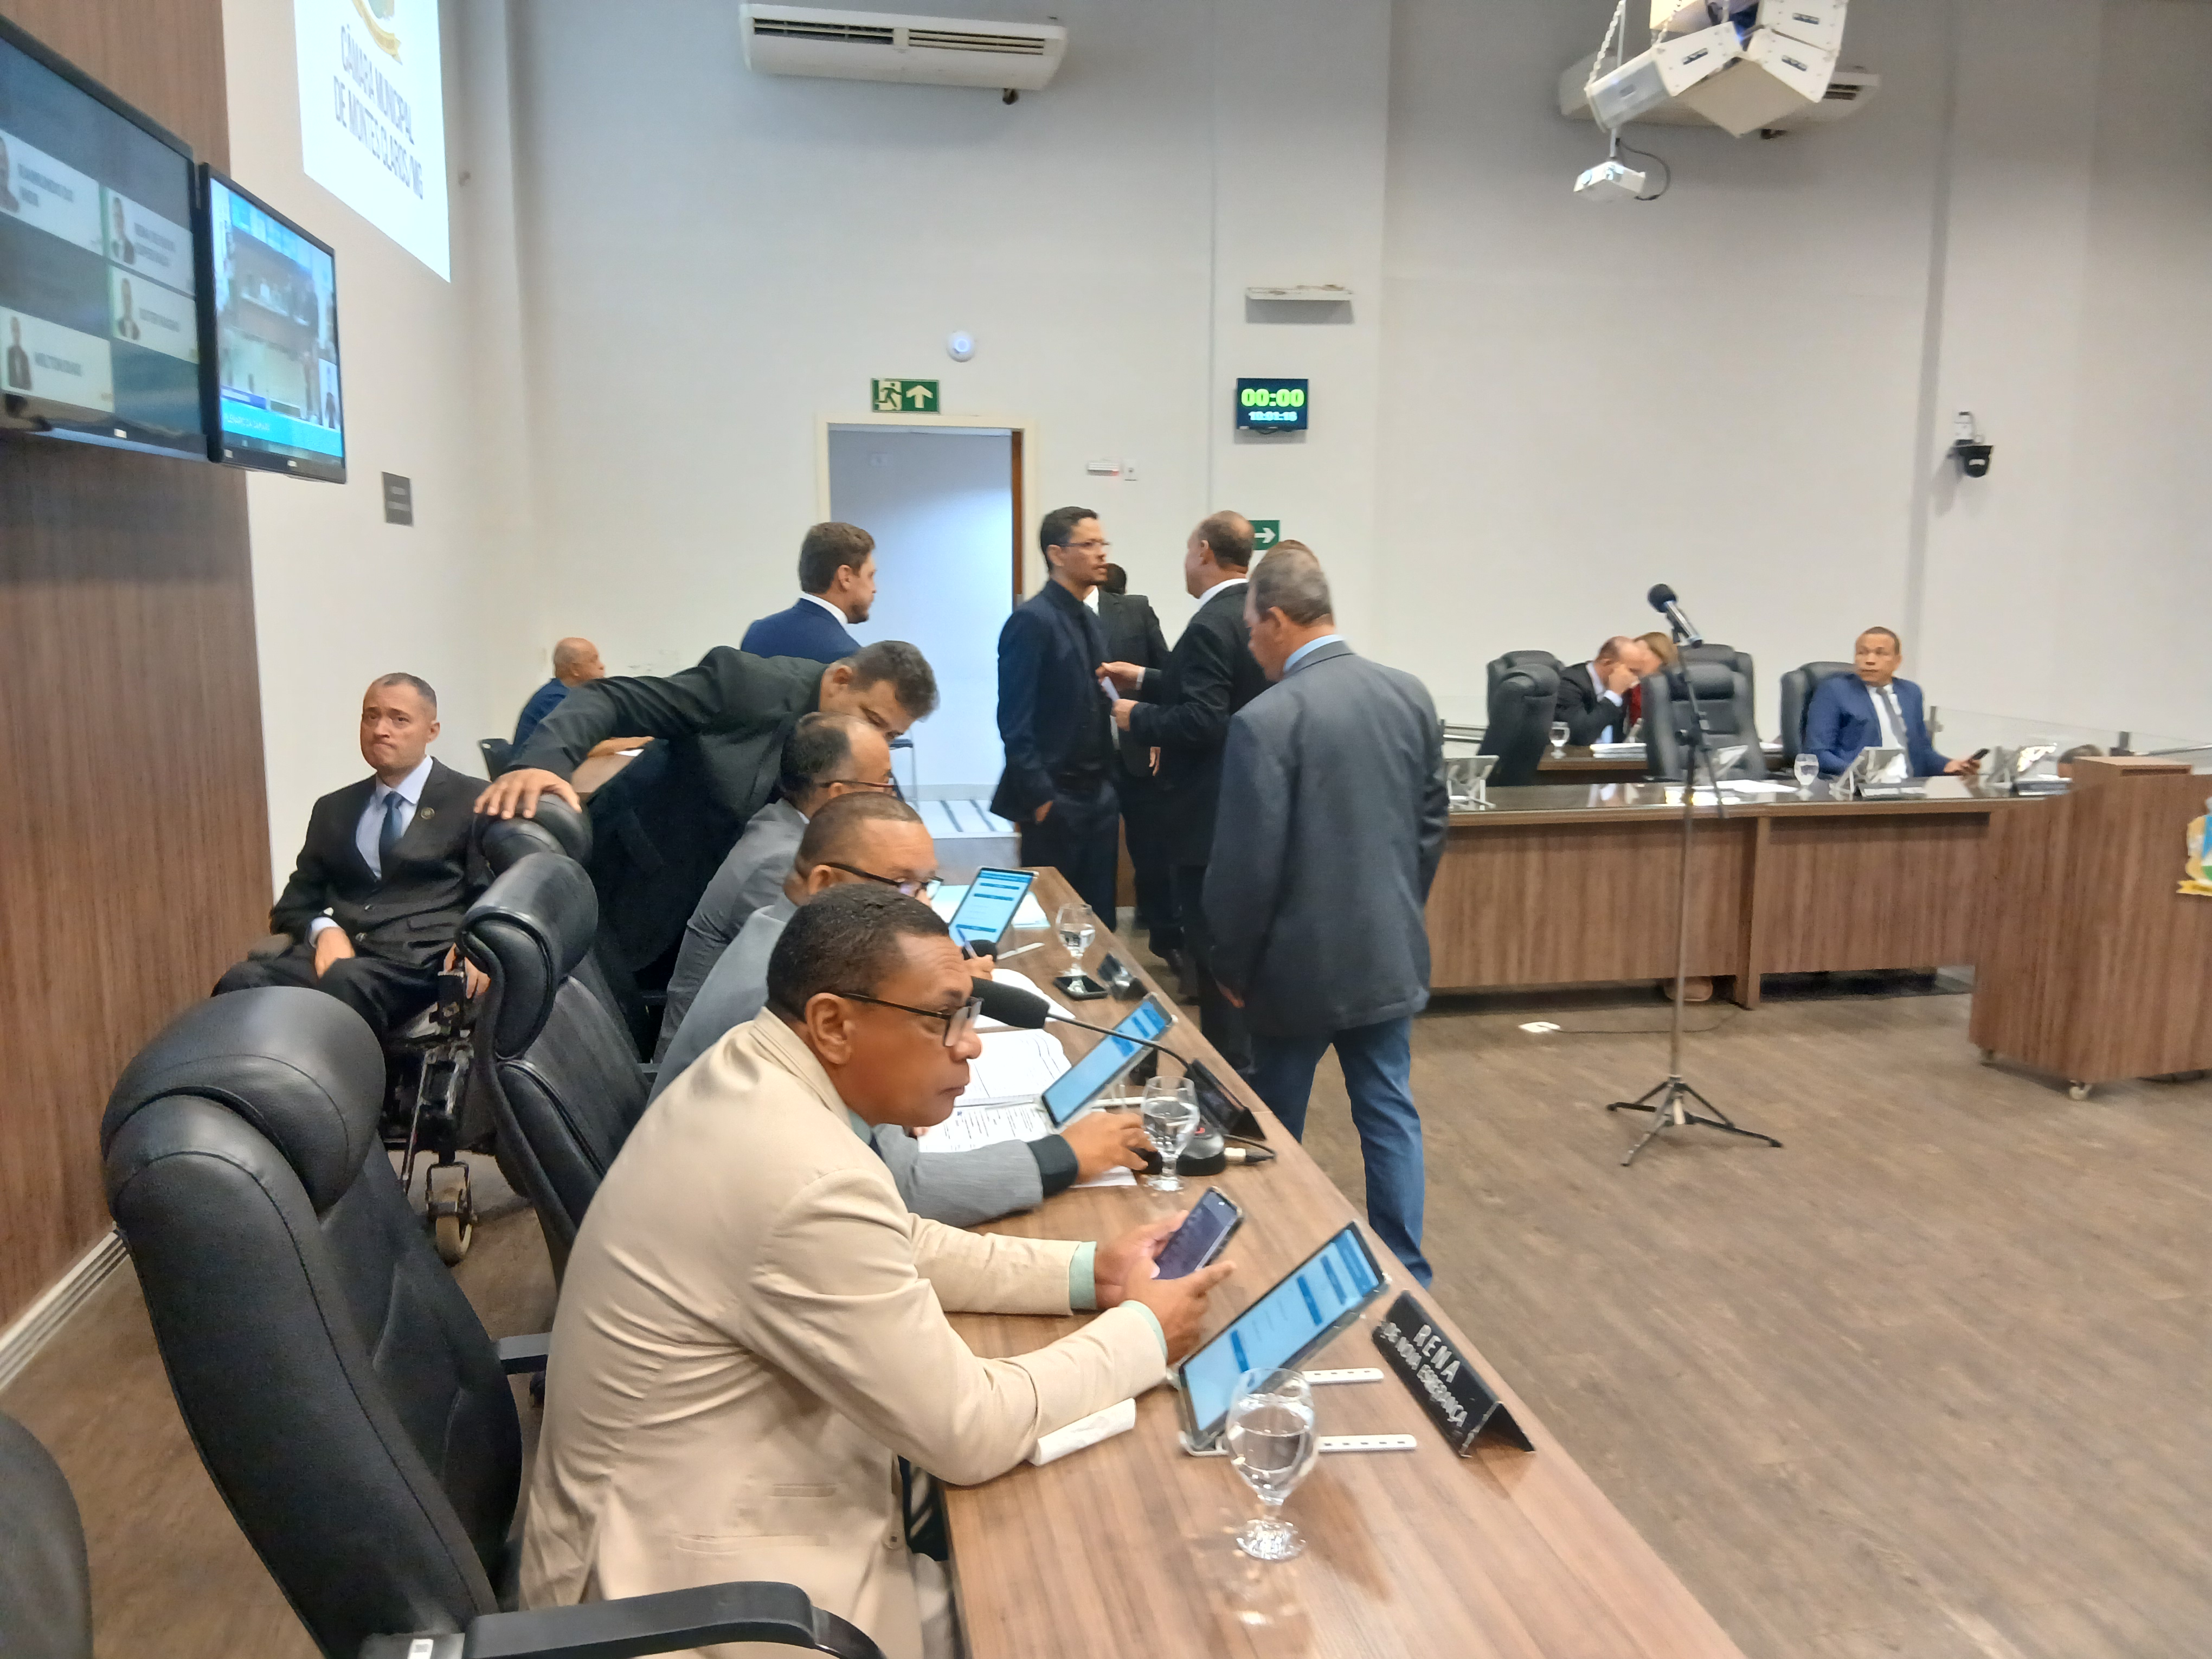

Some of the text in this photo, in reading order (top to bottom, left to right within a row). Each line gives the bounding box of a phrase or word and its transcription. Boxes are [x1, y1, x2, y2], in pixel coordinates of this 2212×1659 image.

[333, 75, 348, 129] DE
[348, 88, 380, 160] MONTES
[375, 66, 415, 146] MUNICIPAL
[1241, 388, 1304, 407] 00:00
